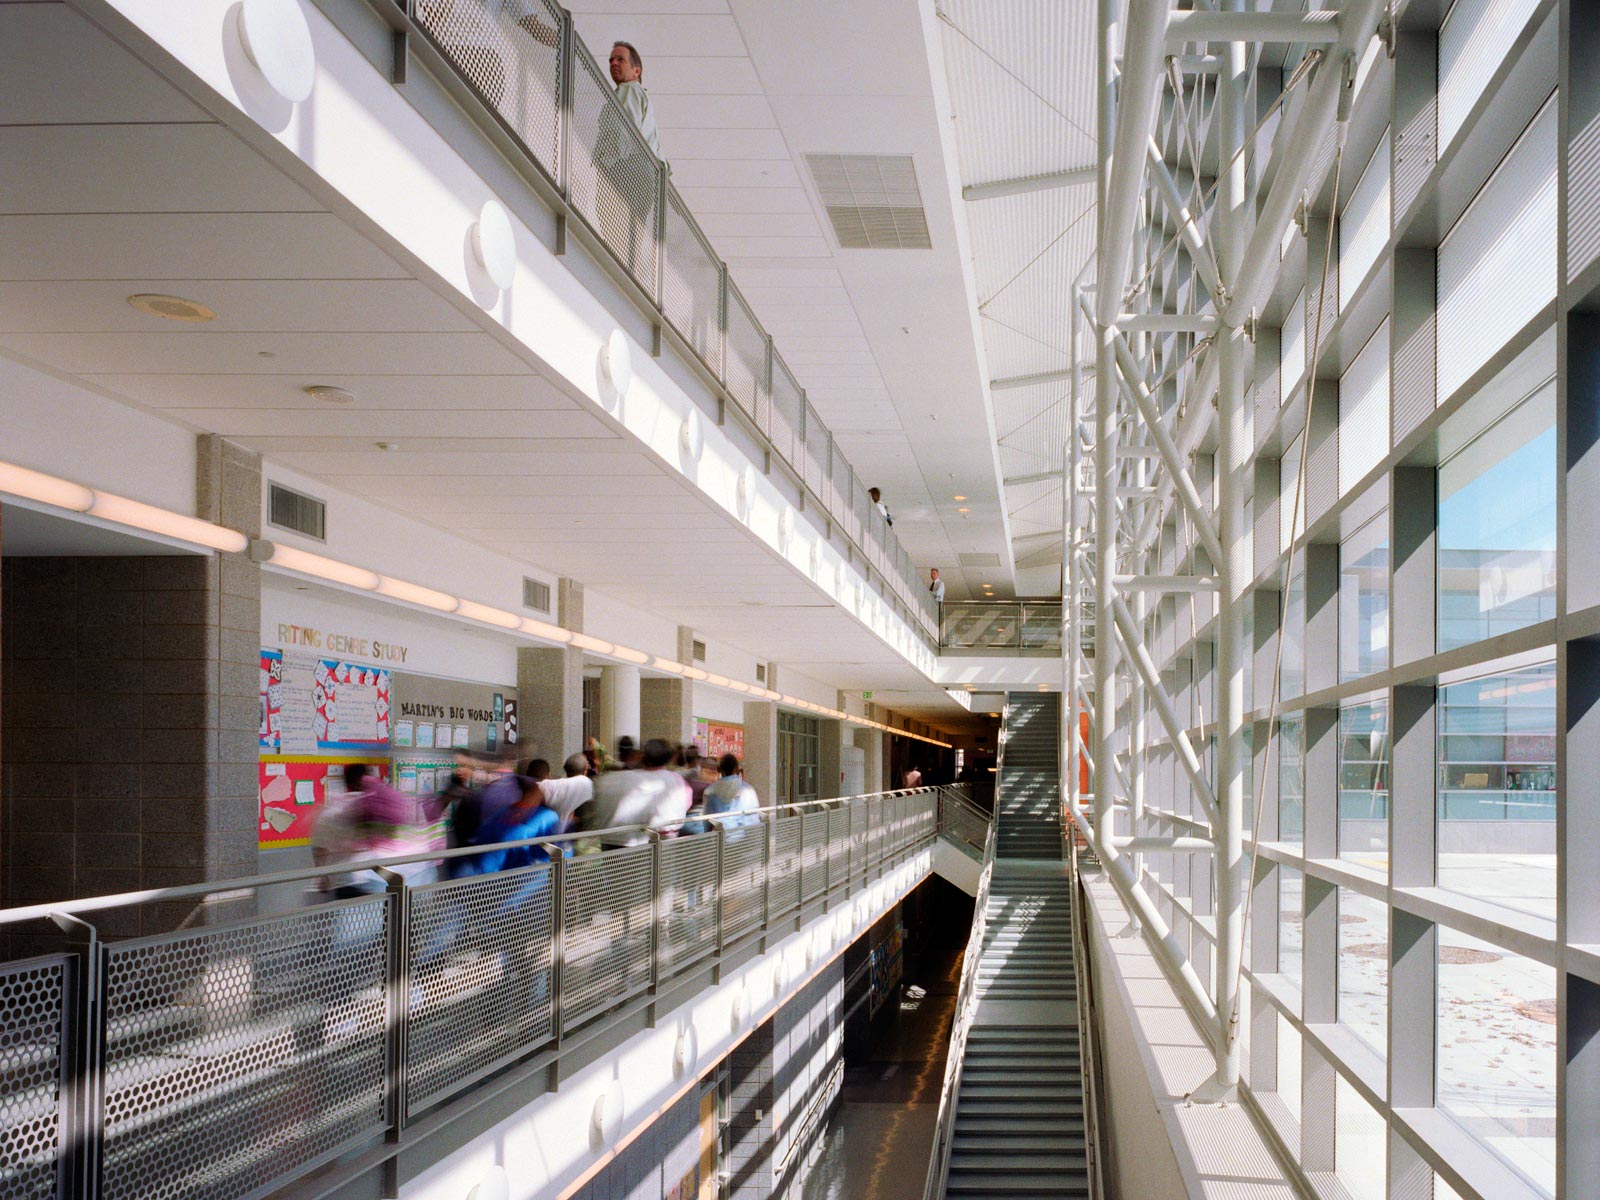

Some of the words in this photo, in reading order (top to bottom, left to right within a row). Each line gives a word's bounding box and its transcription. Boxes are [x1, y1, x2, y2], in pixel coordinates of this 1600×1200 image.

[278, 623, 322, 648] RITING
[326, 633, 368, 656] GENRE
[372, 640, 407, 662] STUDY
[401, 702, 445, 718] MARTIN'S
[449, 706, 465, 719] BIG
[467, 708, 493, 722] WORDS
